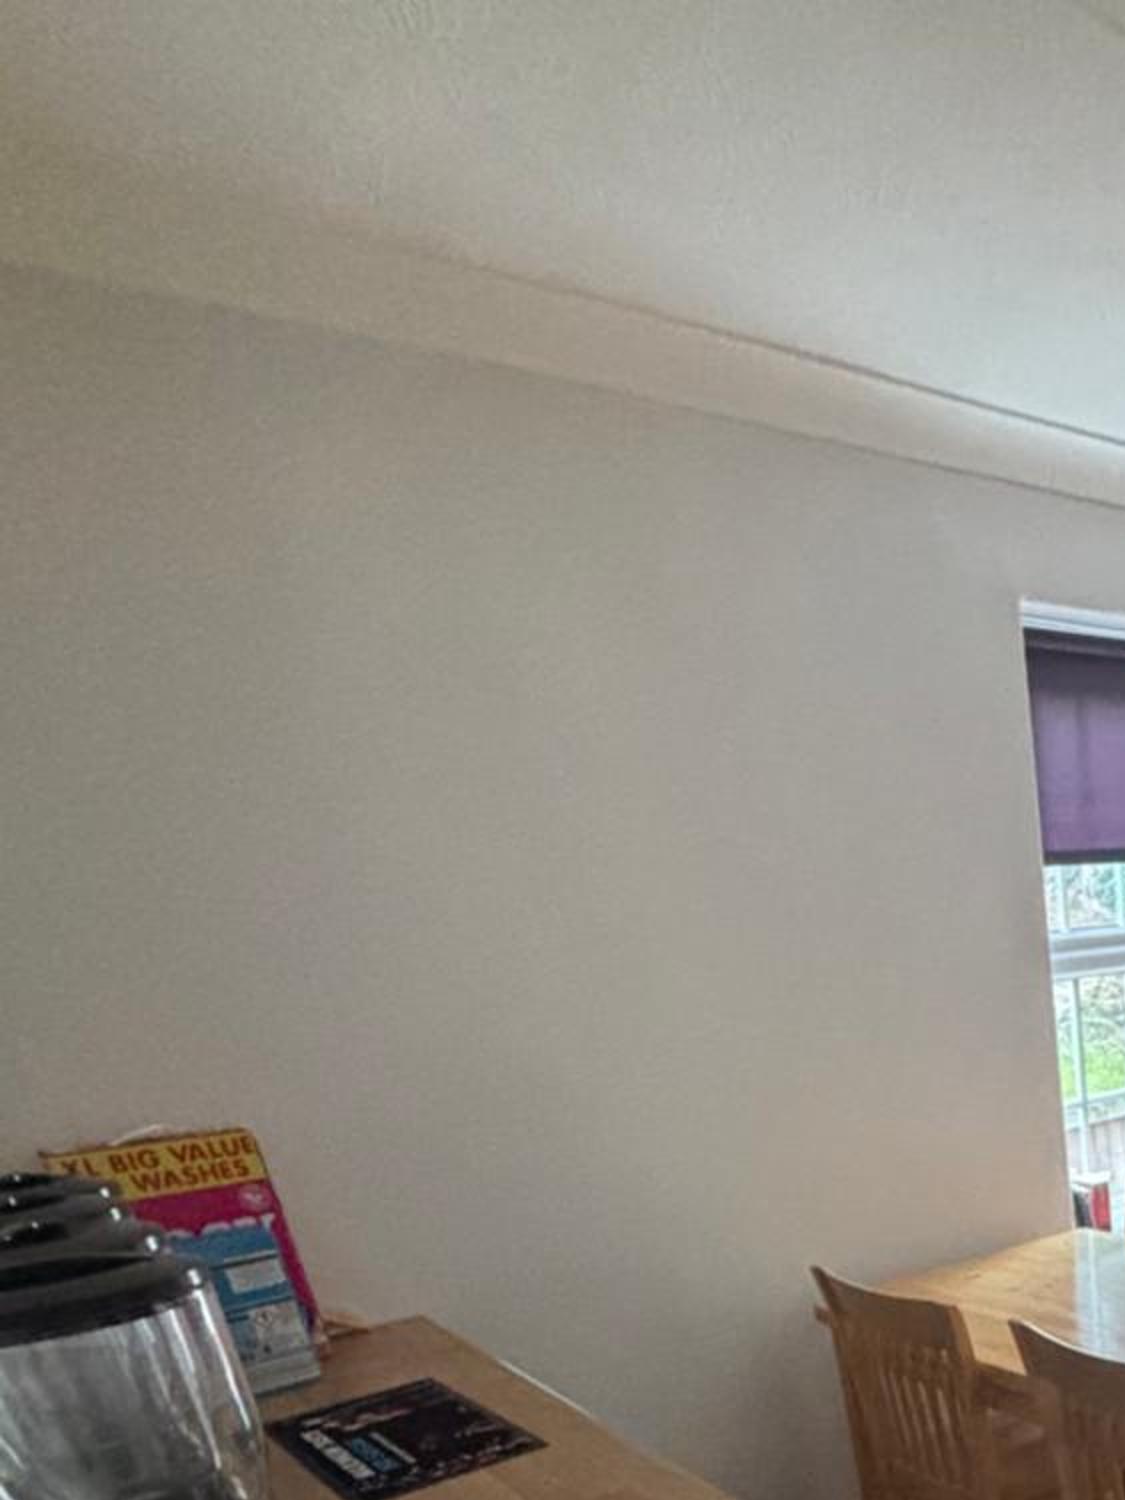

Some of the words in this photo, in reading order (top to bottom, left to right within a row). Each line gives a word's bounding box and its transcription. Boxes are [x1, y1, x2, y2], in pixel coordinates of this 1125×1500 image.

[108, 1149, 161, 1174] BIG
[166, 1134, 257, 1164] VALUE
[128, 1159, 250, 1193] WASHES
